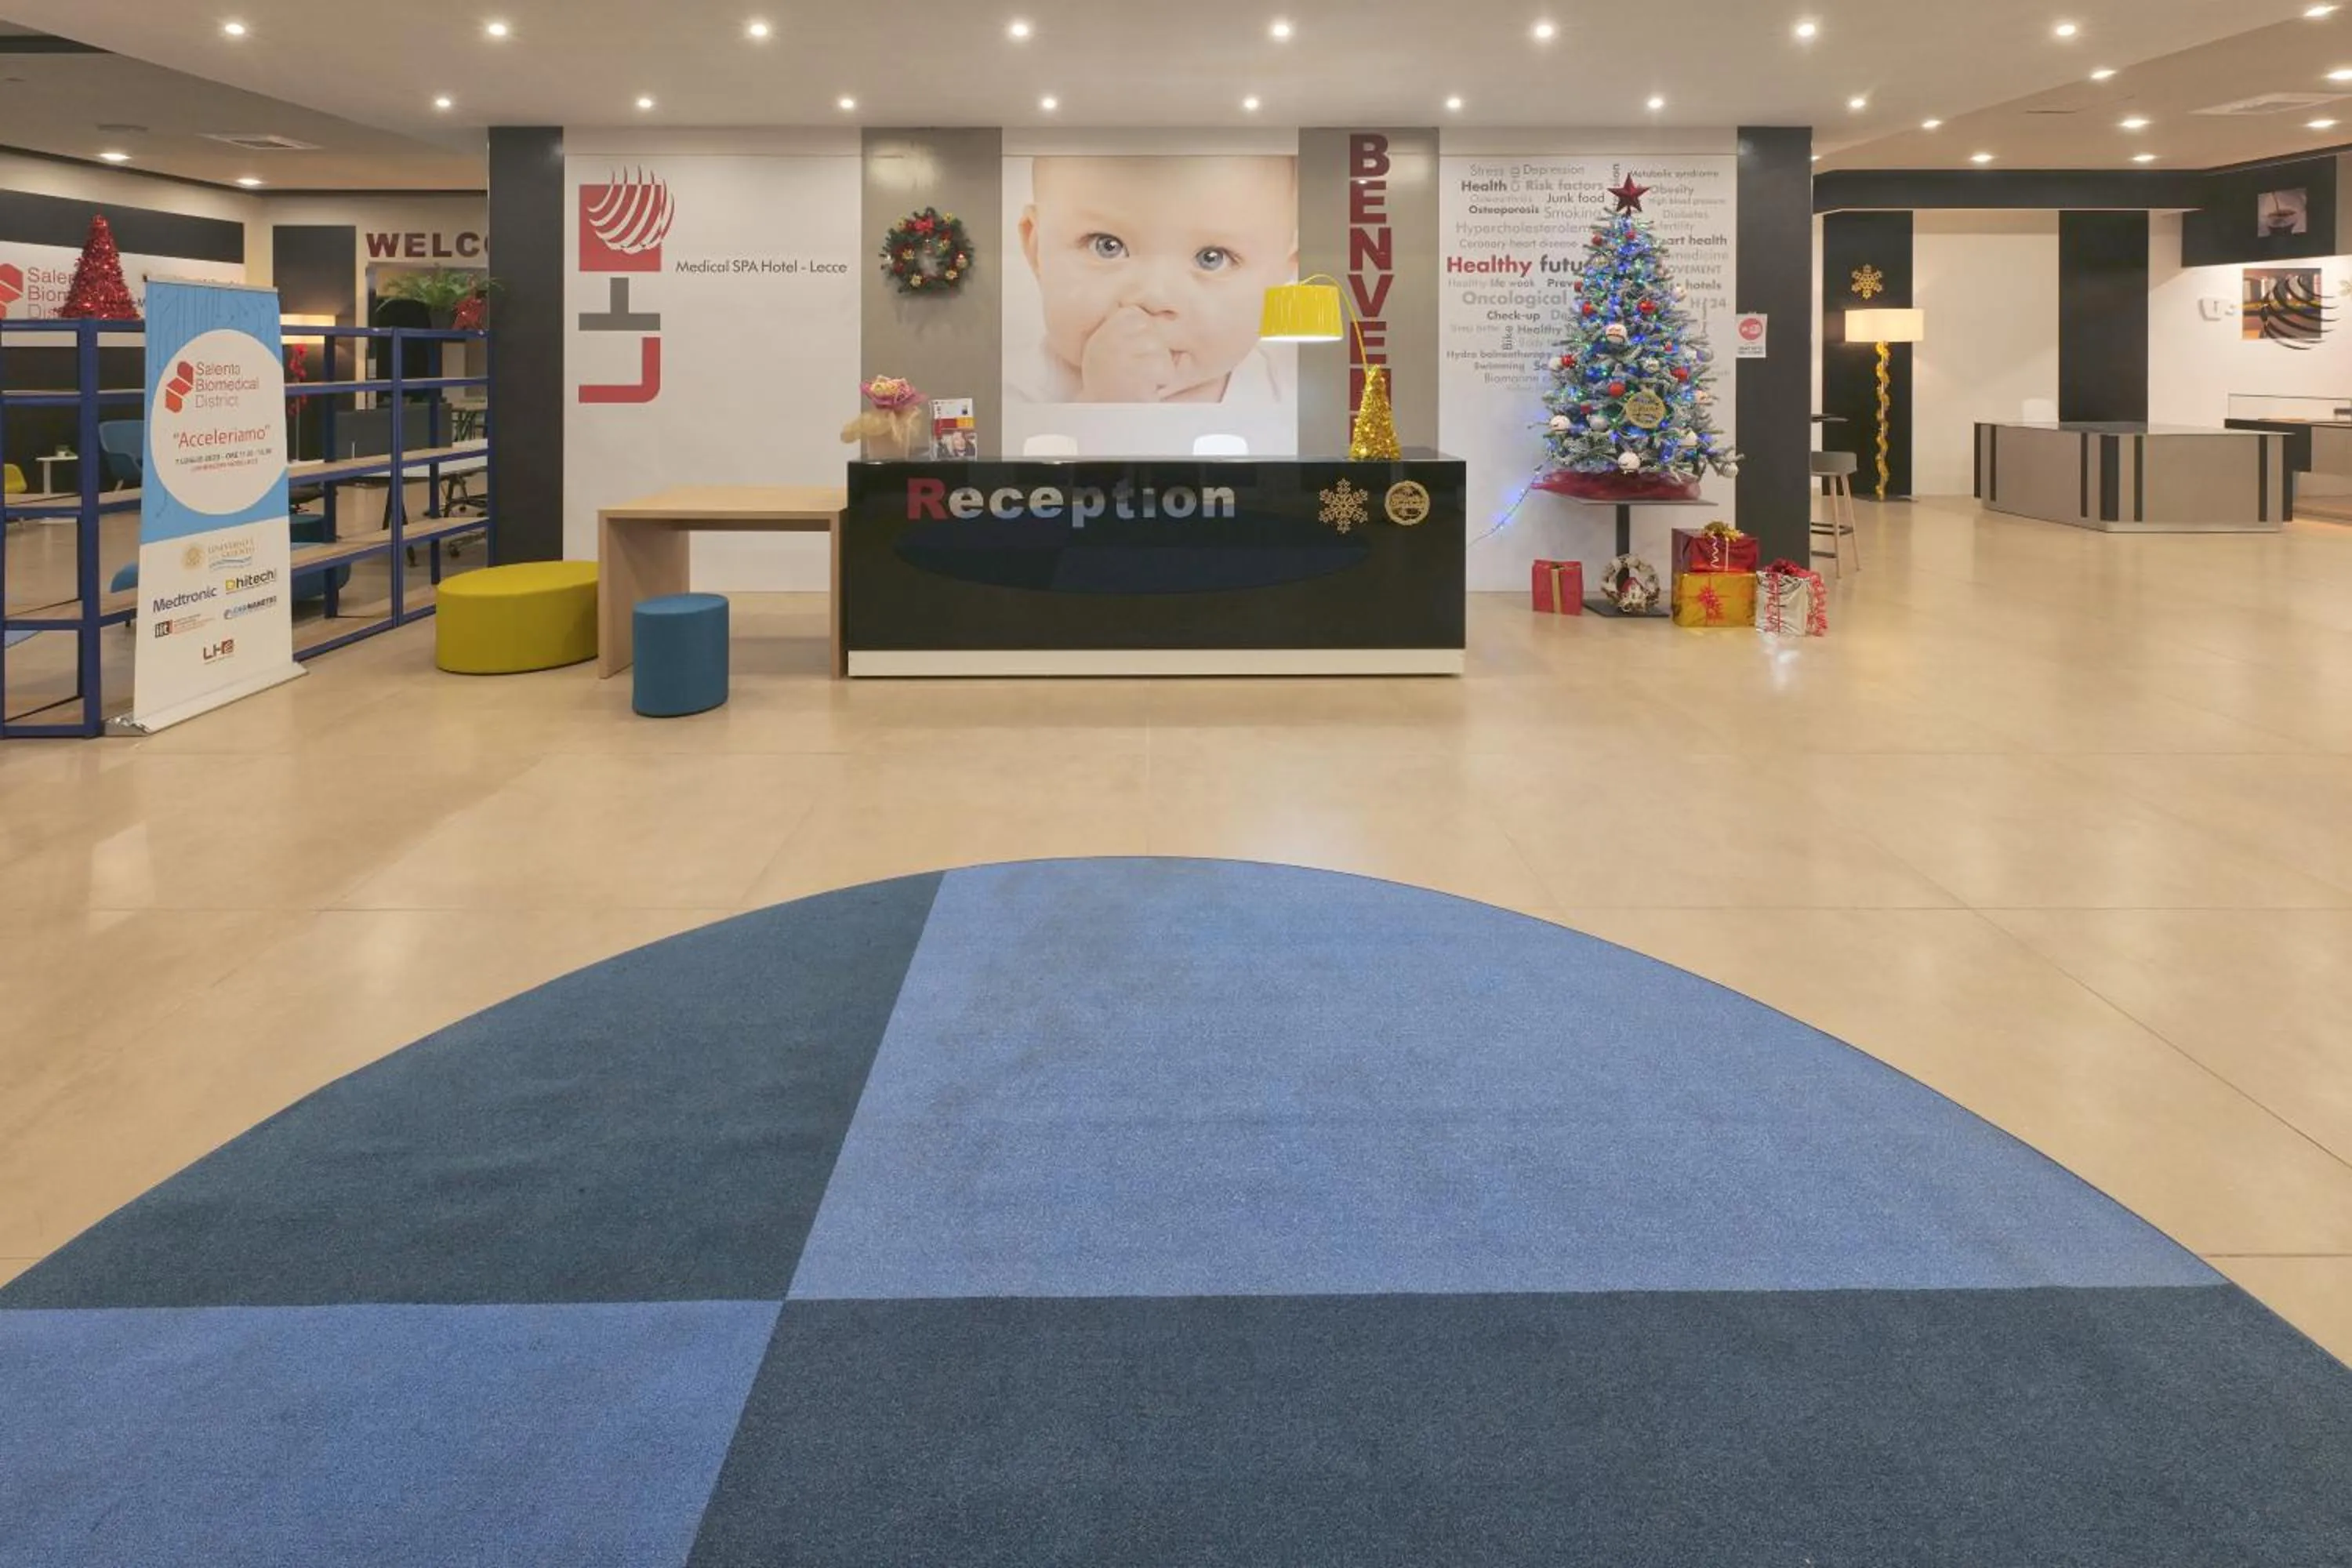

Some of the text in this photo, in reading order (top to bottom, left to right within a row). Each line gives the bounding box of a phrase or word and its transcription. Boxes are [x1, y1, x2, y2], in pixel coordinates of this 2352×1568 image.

[1523, 164, 1584, 177] Depression
[1461, 180, 1508, 192] Health
[1526, 180, 1554, 191] Risk
[1559, 180, 1604, 191] factors
[1650, 183, 1694, 196] Obesity
[1546, 192, 1606, 204] Junk food
[1468, 205, 1540, 216] Osteoporosis
[366, 232, 488, 257] WELC
[1688, 235, 1728, 245] health
[676, 260, 730, 274] Medical
[732, 260, 758, 273] SPA
[761, 260, 797, 273] Hotel
[810, 261, 848, 273] Lecce
[1446, 254, 1584, 278] Healthy futu
[1669, 264, 1722, 274] OVEMENT
[27, 267, 74, 284] Salen
[1686, 279, 1722, 290] hotels
[1462, 290, 1567, 308] Oncological
[1486, 310, 1541, 324] Check-up
[1517, 325, 1563, 337] Healthy
[196, 361, 241, 376] Salento
[195, 377, 260, 392] Biomedical
[195, 394, 239, 409] District
[907, 478, 1236, 528] Reception
[153, 587, 218, 614] Medtronic
